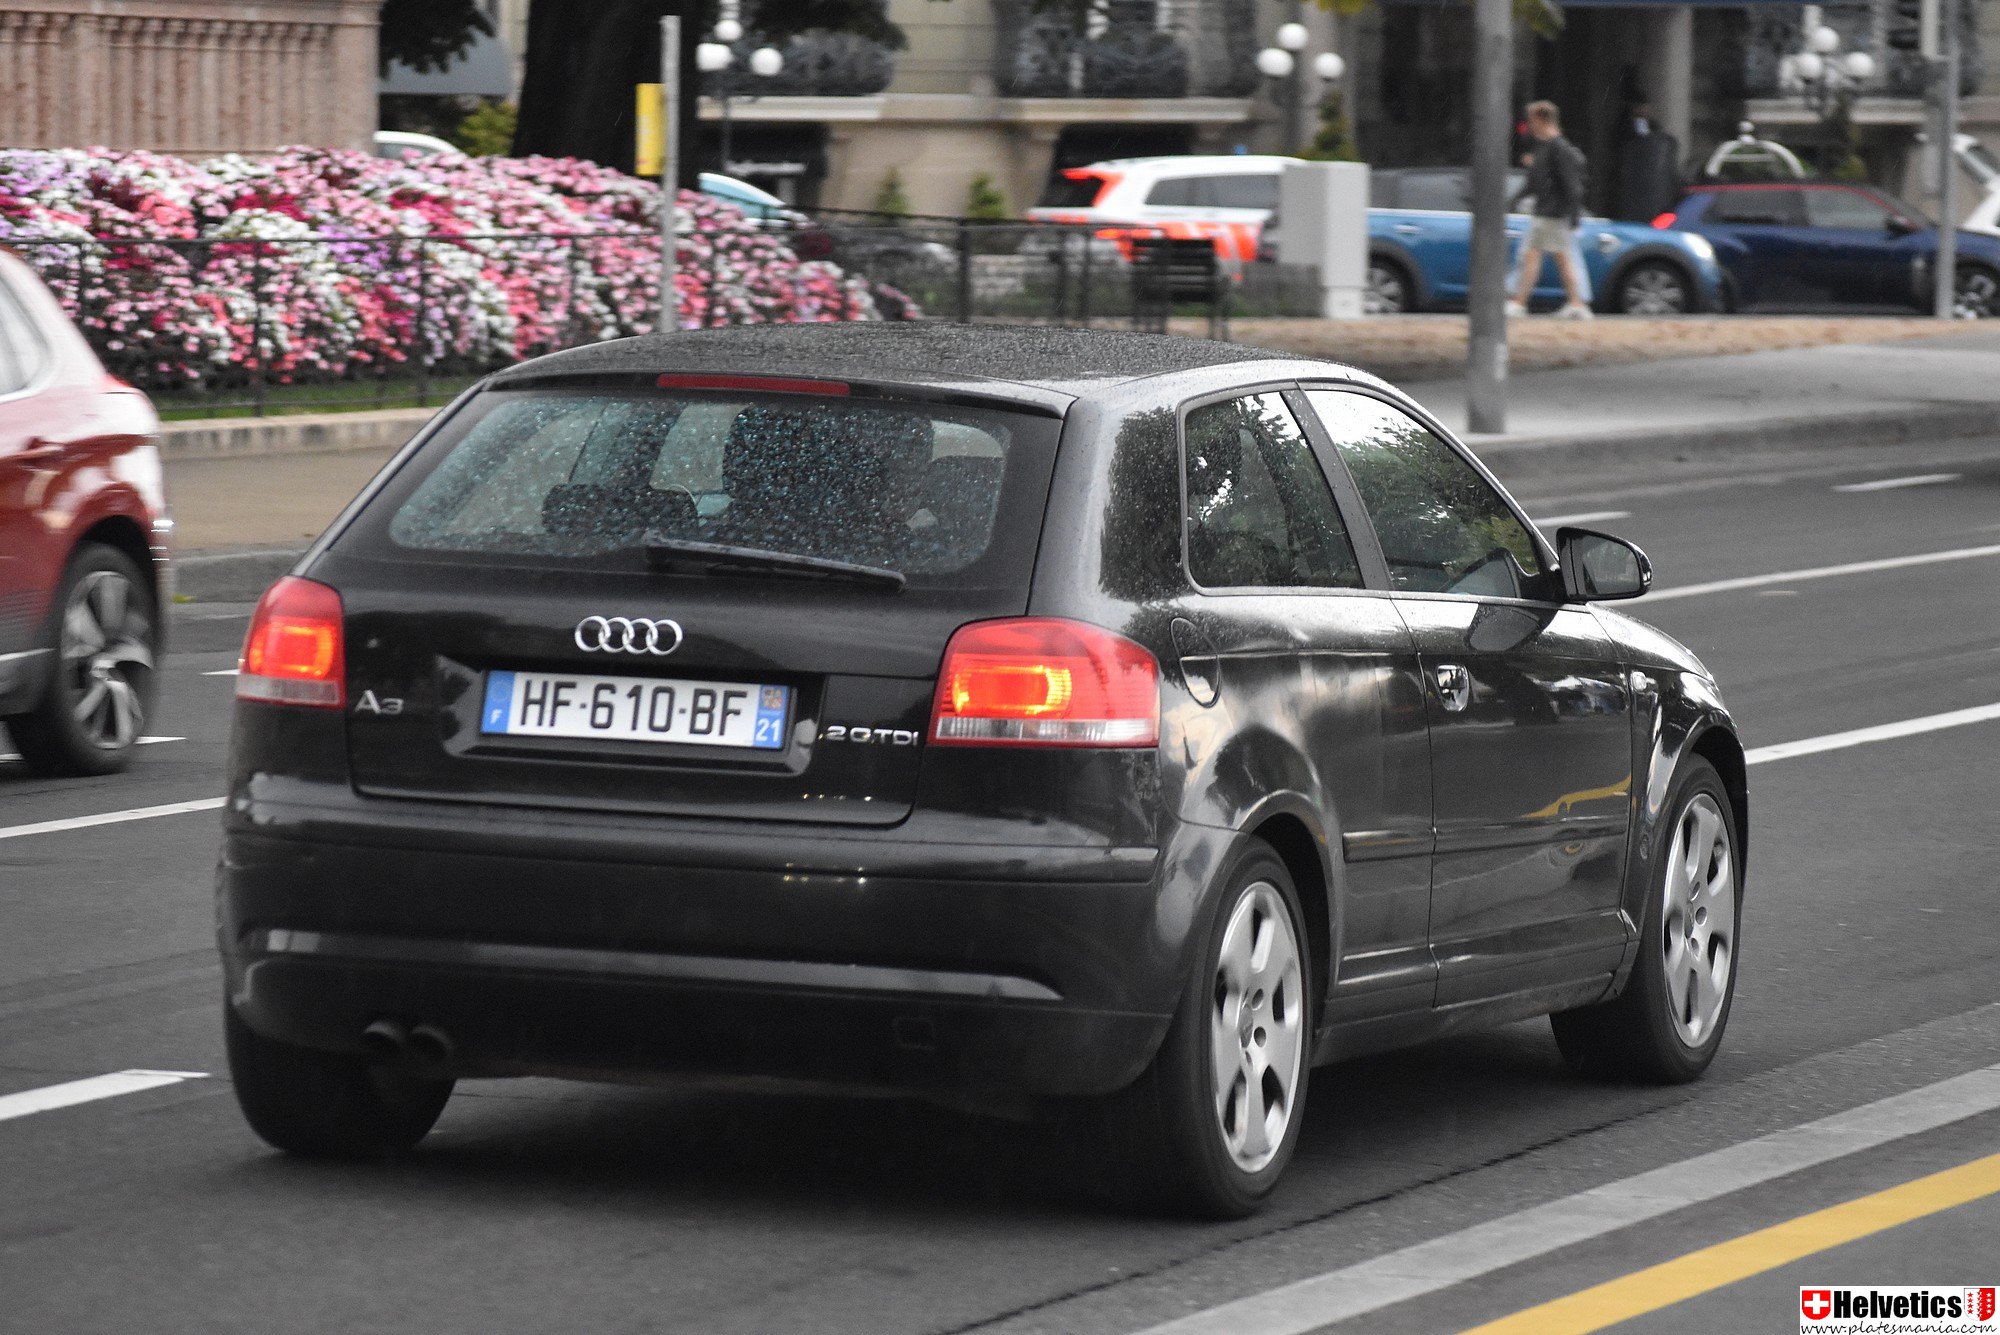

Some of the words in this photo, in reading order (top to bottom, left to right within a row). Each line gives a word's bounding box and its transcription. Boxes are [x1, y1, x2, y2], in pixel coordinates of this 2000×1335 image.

[354, 690, 404, 715] A3
[520, 680, 747, 736] HF-610-BF
[756, 718, 781, 742] 21
[873, 728, 919, 746] TDI
